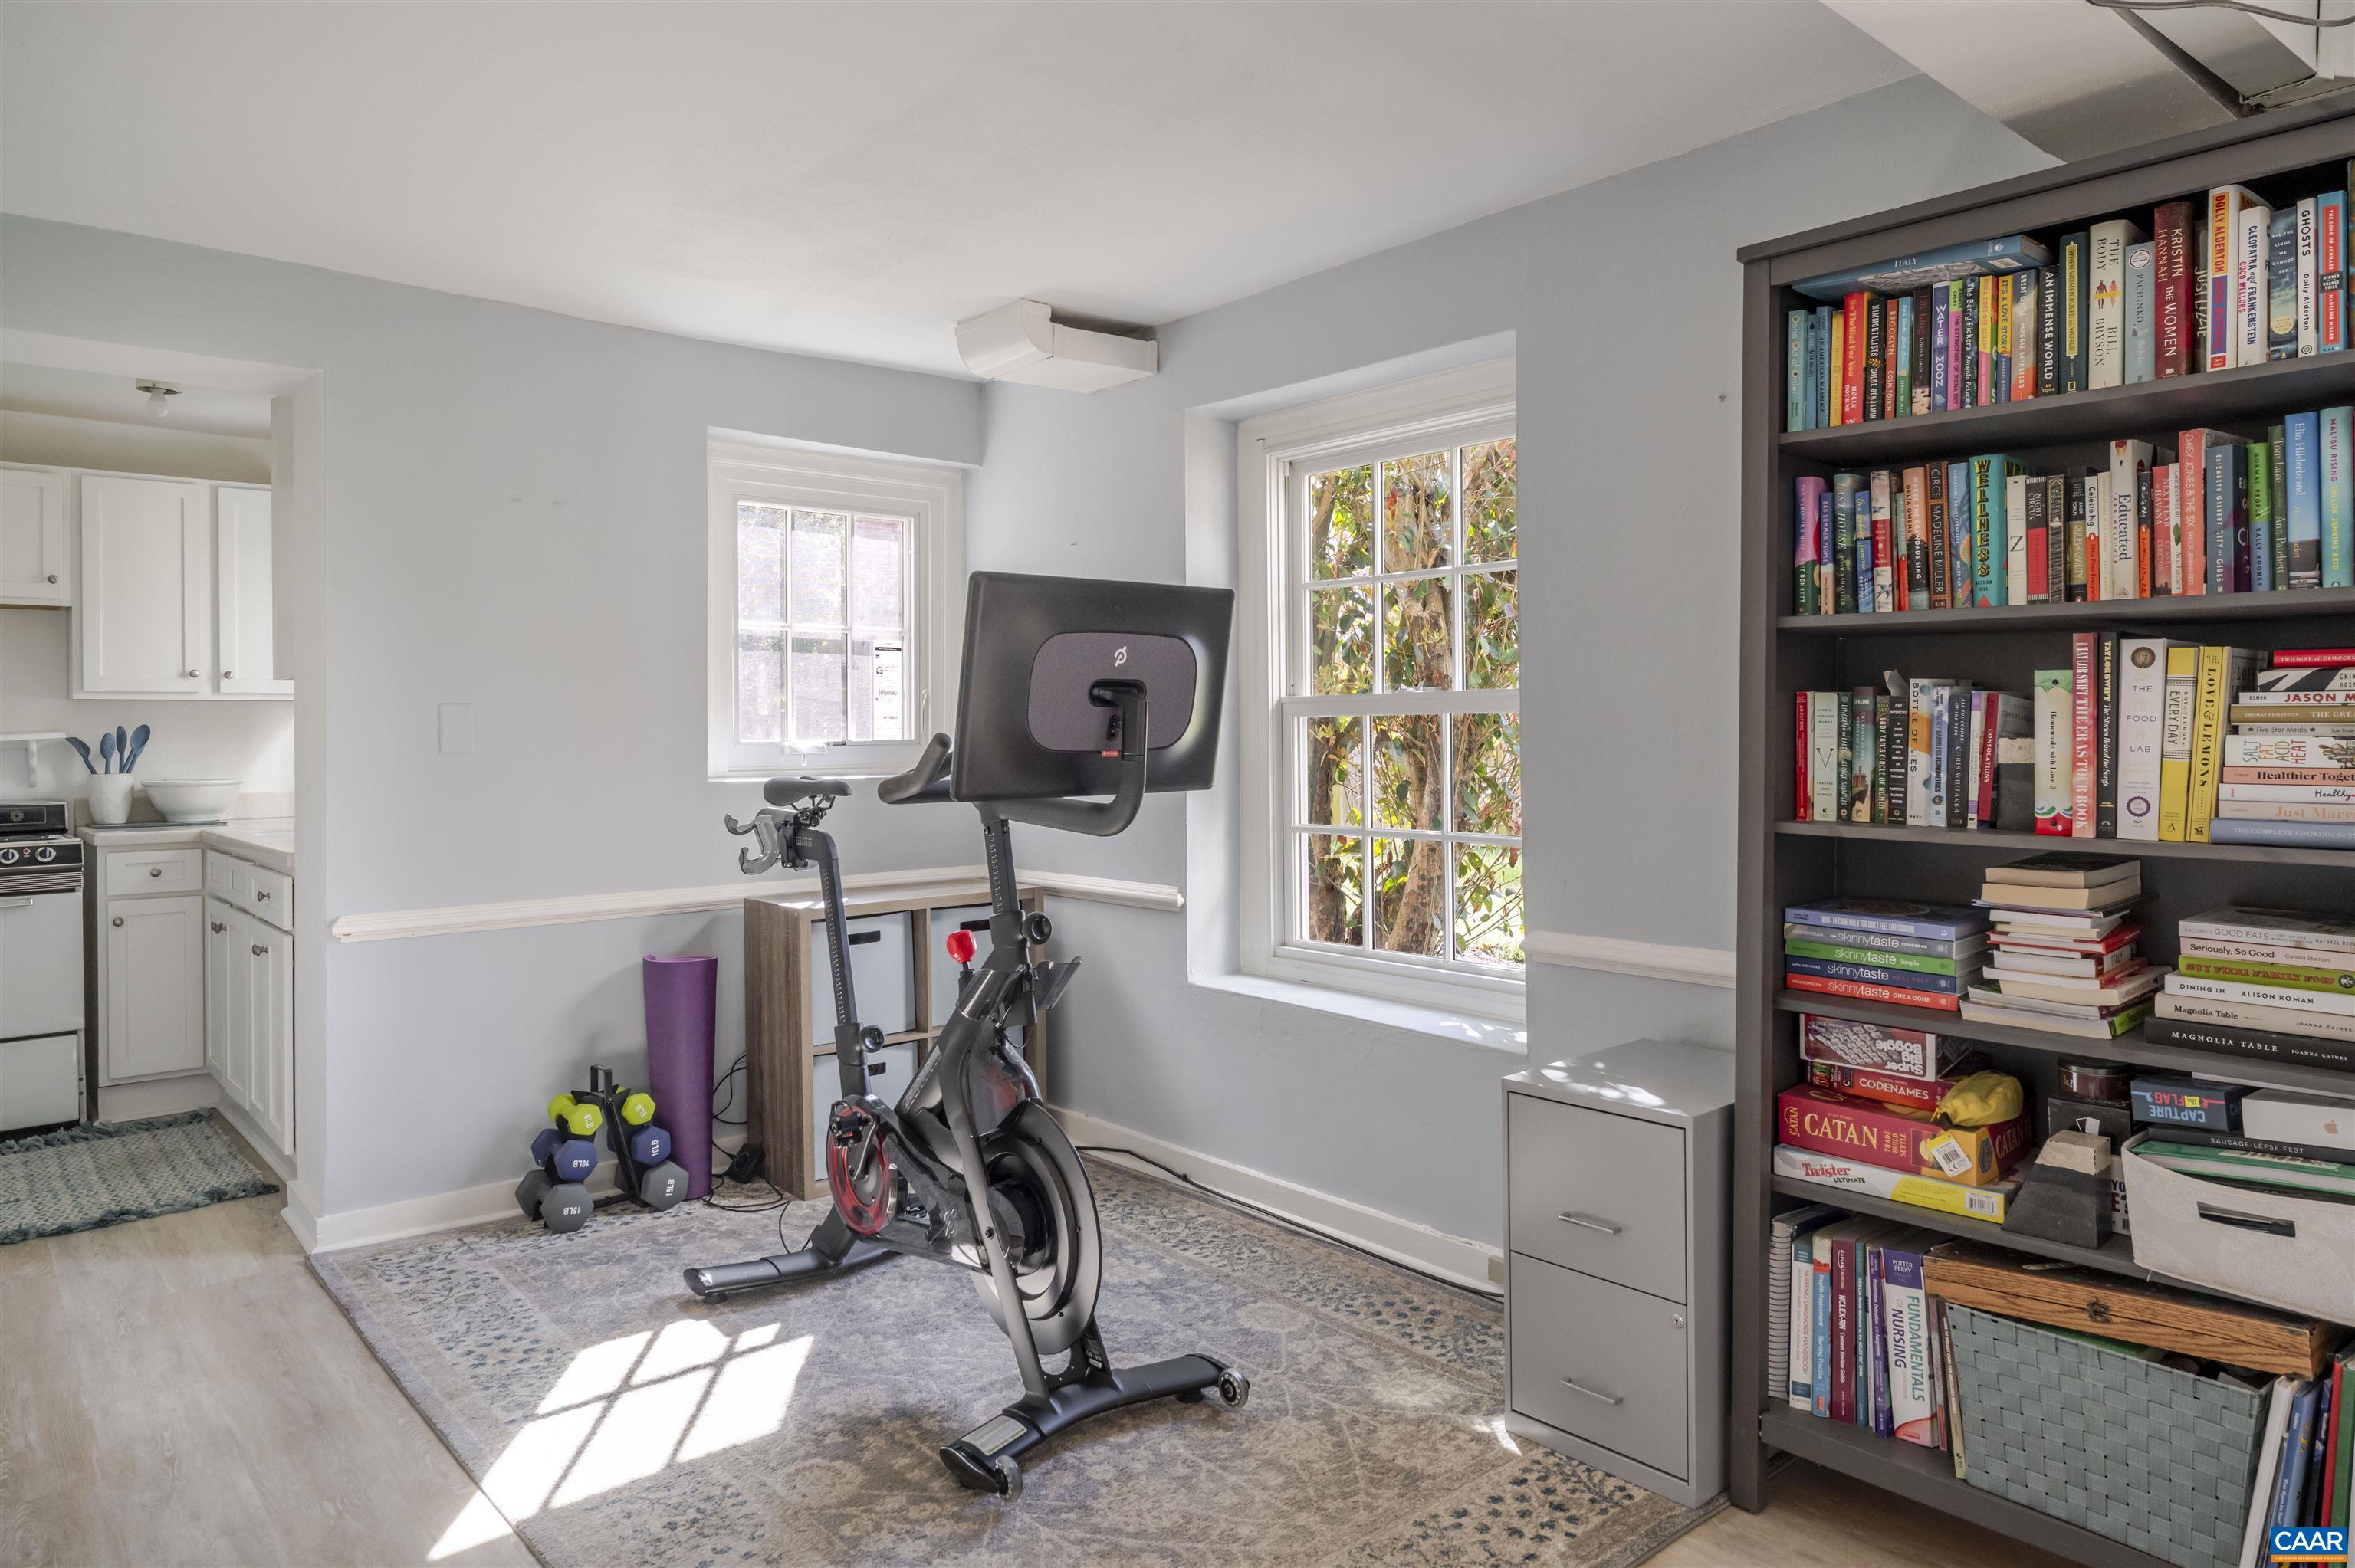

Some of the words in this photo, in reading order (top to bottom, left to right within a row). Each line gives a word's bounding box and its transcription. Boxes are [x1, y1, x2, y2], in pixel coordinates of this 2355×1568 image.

[2215, 195, 2225, 224] DOLLY
[2301, 209, 2311, 257] GHOSTS
[2097, 238, 2107, 271] BODY
[2109, 239, 2120, 266] THE
[2158, 230, 2169, 282] HANNAH
[2171, 228, 2183, 277] KRISTIN
[2215, 226, 2225, 273] ALDERTON
[2248, 225, 2258, 271] CLEOPATRA
[1894, 258, 1917, 267] ITALY
[1966, 282, 1975, 297] The
[2045, 272, 2054, 284] AN
[2249, 271, 2258, 284] and
[2136, 274, 2145, 323] PACHINKO
[2166, 285, 2174, 300] THE
[1965, 299, 1974, 321] Berry
[2045, 290, 2054, 339] IMMENSE
[2247, 286, 2257, 345] FRANKENSTEIN
[1936, 304, 1947, 345] WATER
[1966, 323, 1975, 351] Pickers
[2164, 303, 2177, 357] WOMEN
[2094, 317, 2105, 366] BRYSON
[2107, 326, 2117, 355] BILL
[1935, 356, 1944, 388] MOON
[2045, 342, 2054, 379] WORLD
[2294, 422, 2304, 443] Elin
[2294, 444, 2306, 496] Hilderbrand
[1931, 469, 1941, 498] CIRCE
[1933, 505, 1943, 556] MADELINE
[1974, 459, 1992, 578] WELLNESS
[2087, 516, 2096, 526] Ng
[2118, 494, 2132, 561] Educated
[2275, 517, 2285, 536] Ann
[2010, 536, 2024, 552] Z
[2275, 537, 2286, 573] Patchett
[1934, 557, 1943, 592] MILLER
[2075, 646, 2089, 674] TAYLOR
[2075, 674, 2089, 696] SWIFT
[2205, 668, 2217, 707] LOVE
[1910, 682, 1919, 724] BOTTLE
[2075, 698, 2088, 723] THE
[2169, 691, 2181, 723] EVERY
[2284, 693, 2336, 703] JASON
[1911, 730, 1918, 743] OF
[2075, 726, 2088, 758] ERAS
[2167, 727, 2179, 746] DAY
[1984, 728, 1993, 783] CONSOLATIONS
[2199, 723, 2212, 787] LEMONS
[2243, 740, 2258, 763] SALT
[2258, 743, 2274, 760] FAT
[2275, 740, 2291, 762] ACID
[2290, 739, 2307, 765] HEAT
[2075, 759, 2088, 792] TOUR
[2257, 771, 2317, 781] Healthier
[2075, 795, 2088, 828] BOOK
[1837, 931, 1899, 948] skinnytaste
[2190, 943, 2232, 956] Seriously,
[2235, 947, 2247, 956] So
[2248, 949, 2275, 958] Good
[1834, 948, 1897, 965] skinnytaste
[1899, 958, 1920, 967] Simple
[2186, 963, 2212, 973] GUY
[1828, 963, 1889, 981] skinnytaste
[1828, 979, 1890, 999] skinnytaste
[2179, 983, 2212, 992] DINING
[2241, 991, 2275, 1000] ALISON
[2279, 995, 2314, 1004] ROMAN
[2174, 1005, 2213, 1017] Magnolia
[2215, 1010, 2238, 1020] Table
[1876, 1039, 1923, 1054] Boggle
[2171, 1031, 2234, 1046] MAGNOLIA
[2241, 1041, 2278, 1052] TABLE
[2291, 1048, 2318, 1057] JOANNA
[1885, 1061, 1924, 1075] Super
[1901, 1051, 1923, 1064] Big
[1859, 1078, 1930, 1100] CODENAMES
[2153, 1091, 2186, 1107] FLAG
[583, 1114, 594, 1129] 5LB
[634, 1104, 648, 1117] 5LB
[1789, 1107, 1798, 1136] CATAN
[2149, 1105, 2206, 1124] CAPTURE
[1804, 1112, 1878, 1150] CATAN
[573, 1160, 590, 1168] 10LB
[1802, 1162, 1851, 1178] Twister
[665, 1179, 675, 1197] 15LB
[563, 1206, 581, 1215] 15LB
[1892, 1259, 1913, 1268] POTTER
[1894, 1265, 1913, 1274] PERRY
[1891, 1308, 1907, 1369] NURSING
[1907, 1295, 1925, 1402] FUNDAMENTALS
